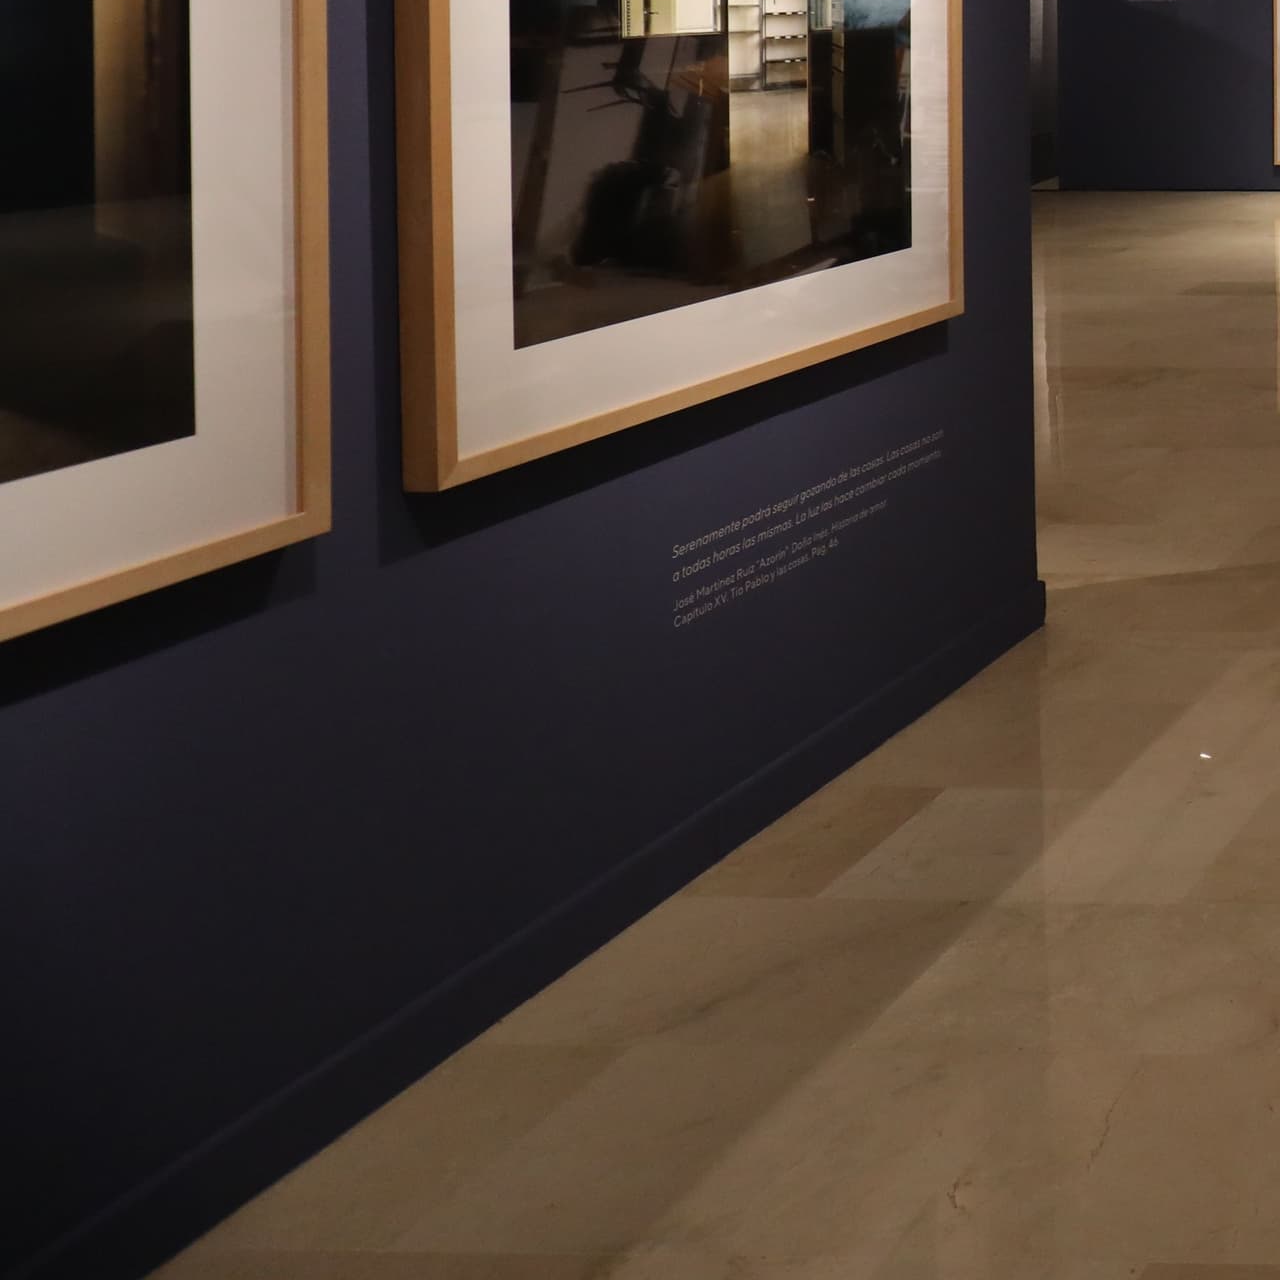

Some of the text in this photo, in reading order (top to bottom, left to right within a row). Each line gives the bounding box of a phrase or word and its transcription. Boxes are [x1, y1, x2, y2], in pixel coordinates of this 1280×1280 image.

[672, 520, 741, 558] Serenamente
[741, 505, 771, 530] podrá
[772, 493, 799, 513] seguir
[800, 476, 837, 504] gozando
[838, 470, 848, 483] de
[886, 448, 900, 462] Las
[672, 570, 680, 582] a
[682, 557, 711, 577] todas
[713, 543, 740, 564] horas
[742, 536, 756, 550] las
[795, 512, 806, 525] La
[808, 505, 820, 519] luz
[821, 499, 833, 511] las
[834, 489, 854, 506] hace
[855, 474, 887, 496] cambiar
[888, 465, 907, 480] cada
[673, 594, 694, 612] José
[697, 574, 736, 600] Martínez
[737, 564, 755, 581] Ruiz
[673, 601, 713, 628] Capítulo
[731, 586, 743, 600] Tío
[745, 573, 769, 592] Pablo
